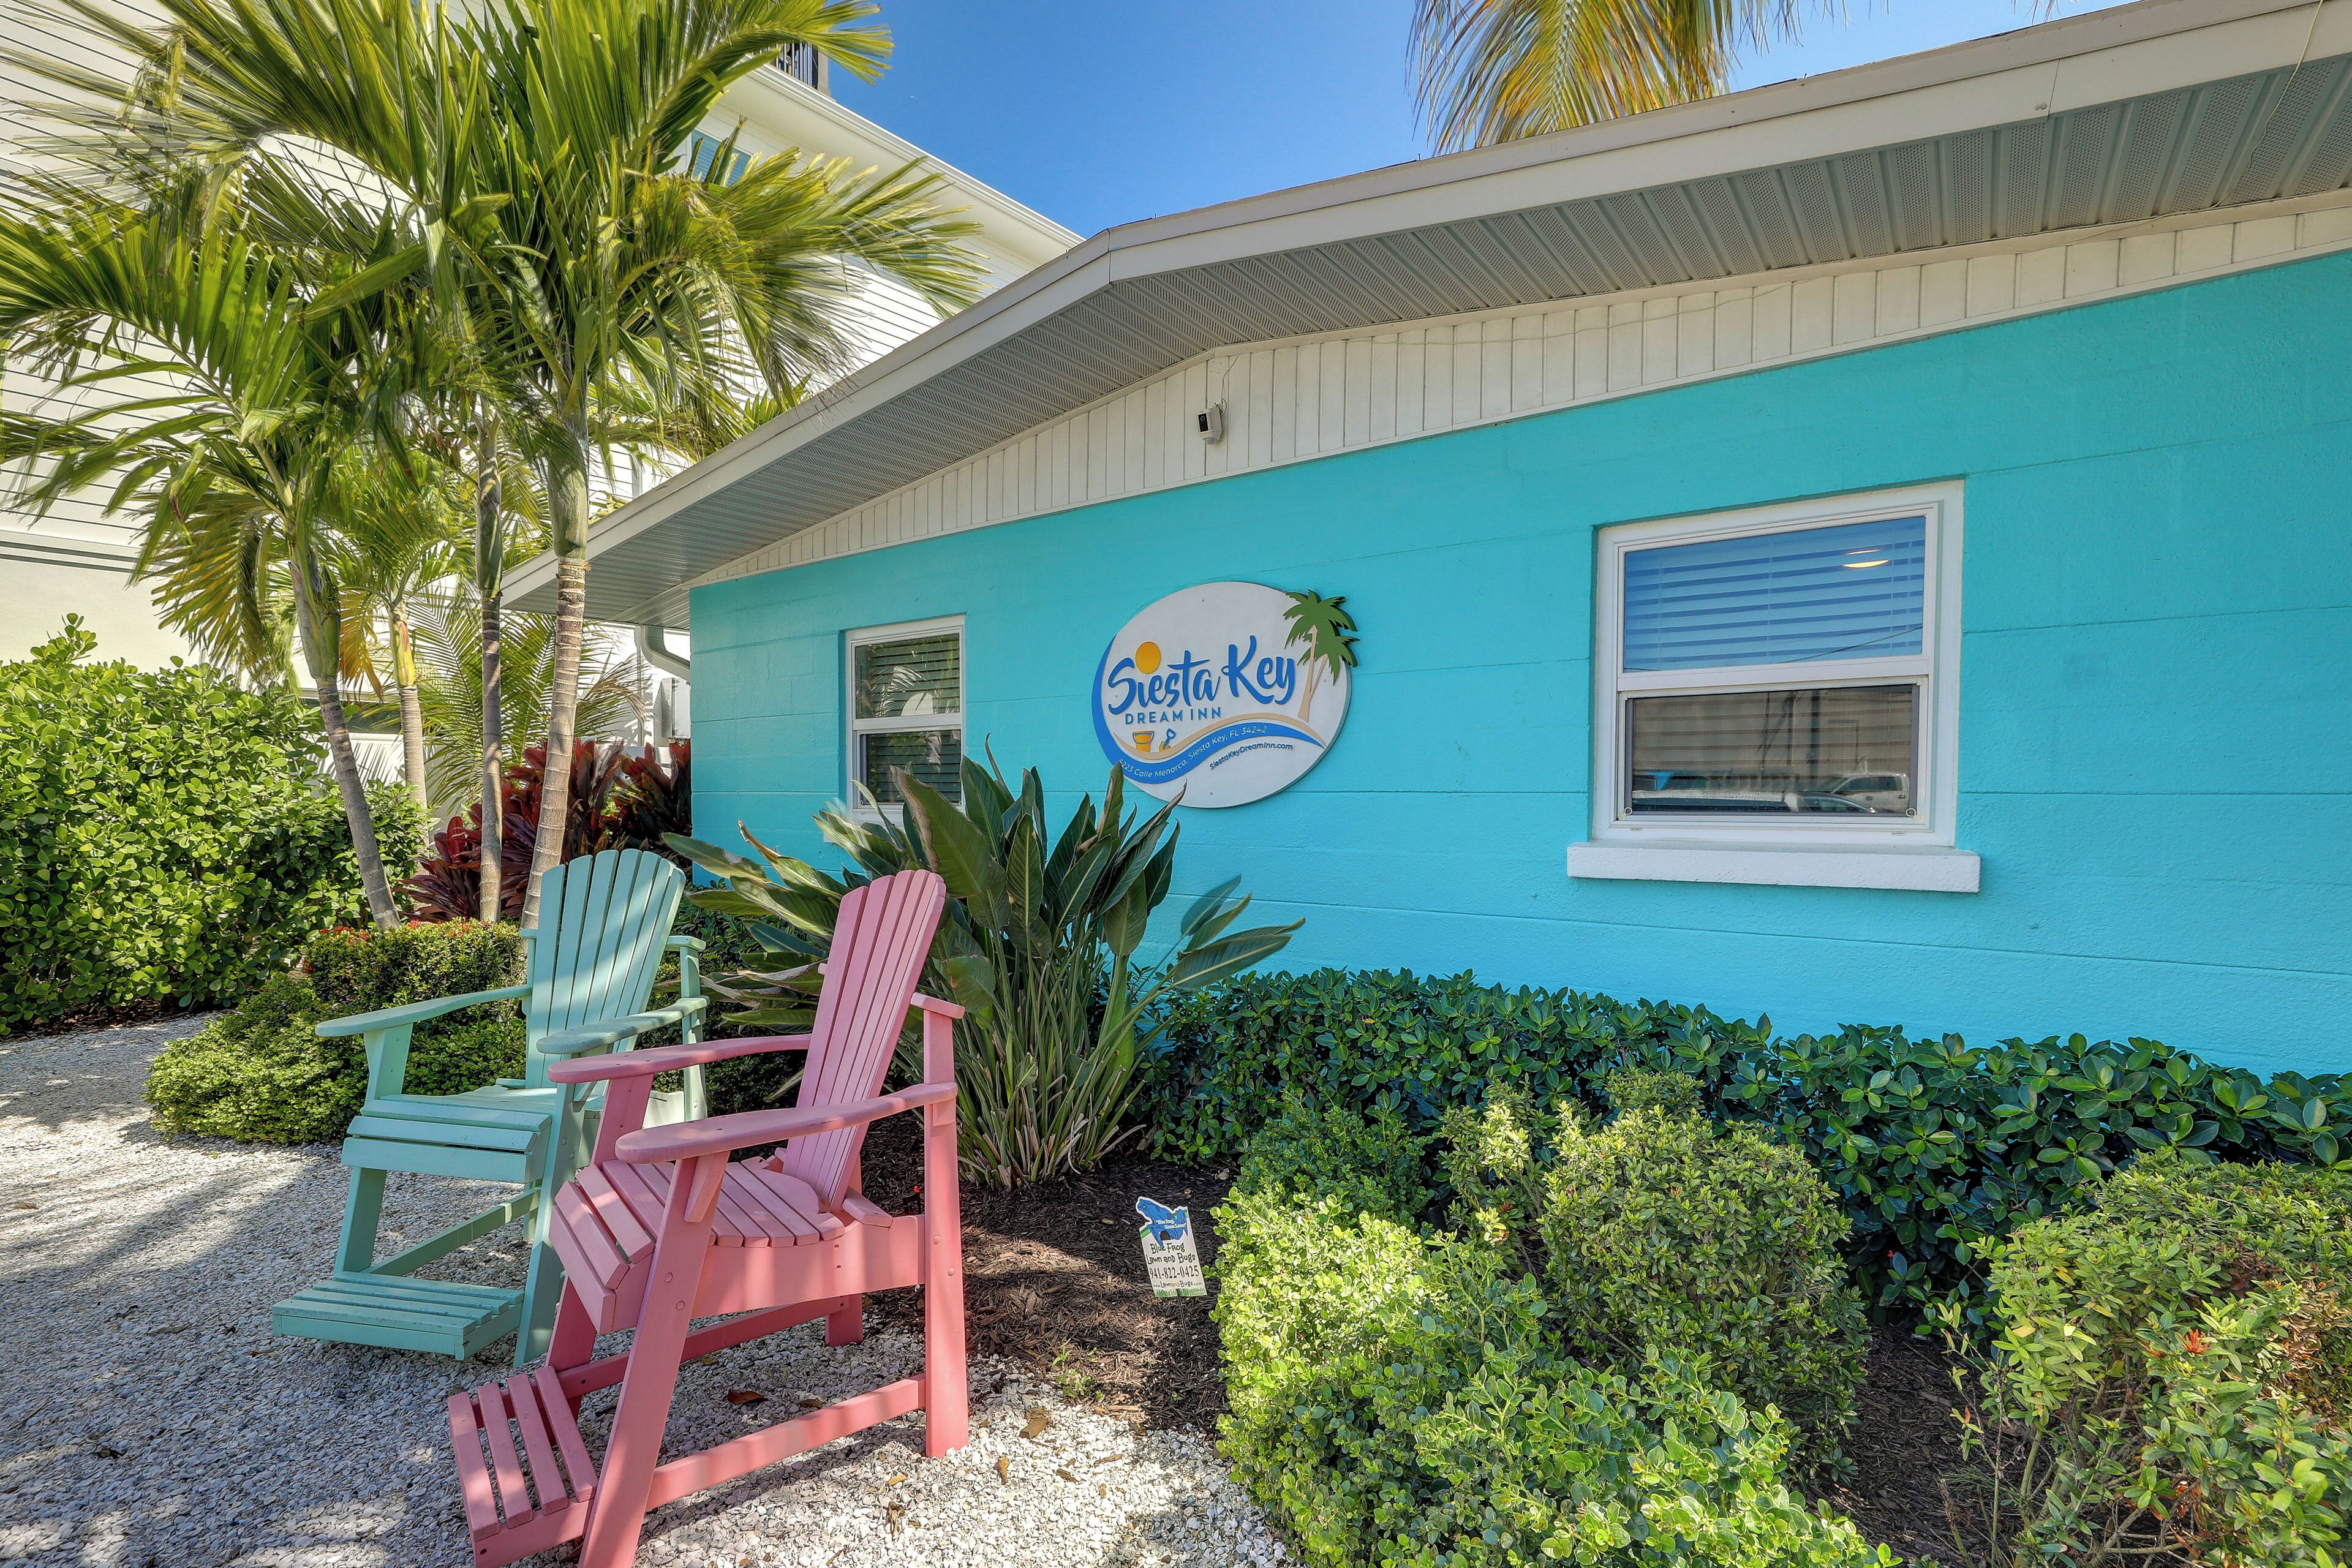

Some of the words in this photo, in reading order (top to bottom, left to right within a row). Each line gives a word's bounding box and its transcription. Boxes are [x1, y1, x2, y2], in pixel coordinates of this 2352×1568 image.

[1108, 650, 1220, 715] Siesta
[1222, 635, 1295, 705] Key
[1125, 709, 1183, 725] DREAM
[1190, 706, 1221, 721] INN
[1134, 769, 1153, 778] Calle
[1188, 742, 1210, 760] Siesta
[1212, 734, 1228, 745] Key,
[1241, 725, 1267, 735] 34242
[1209, 742, 1294, 770] SiestaKeyDreamInn.com
[1150, 1243, 1166, 1254] Blue
[1146, 1254, 1163, 1264] Lawn
[1177, 1253, 1196, 1264] Bugs
[1149, 1265, 1199, 1279] 941-822-0425
